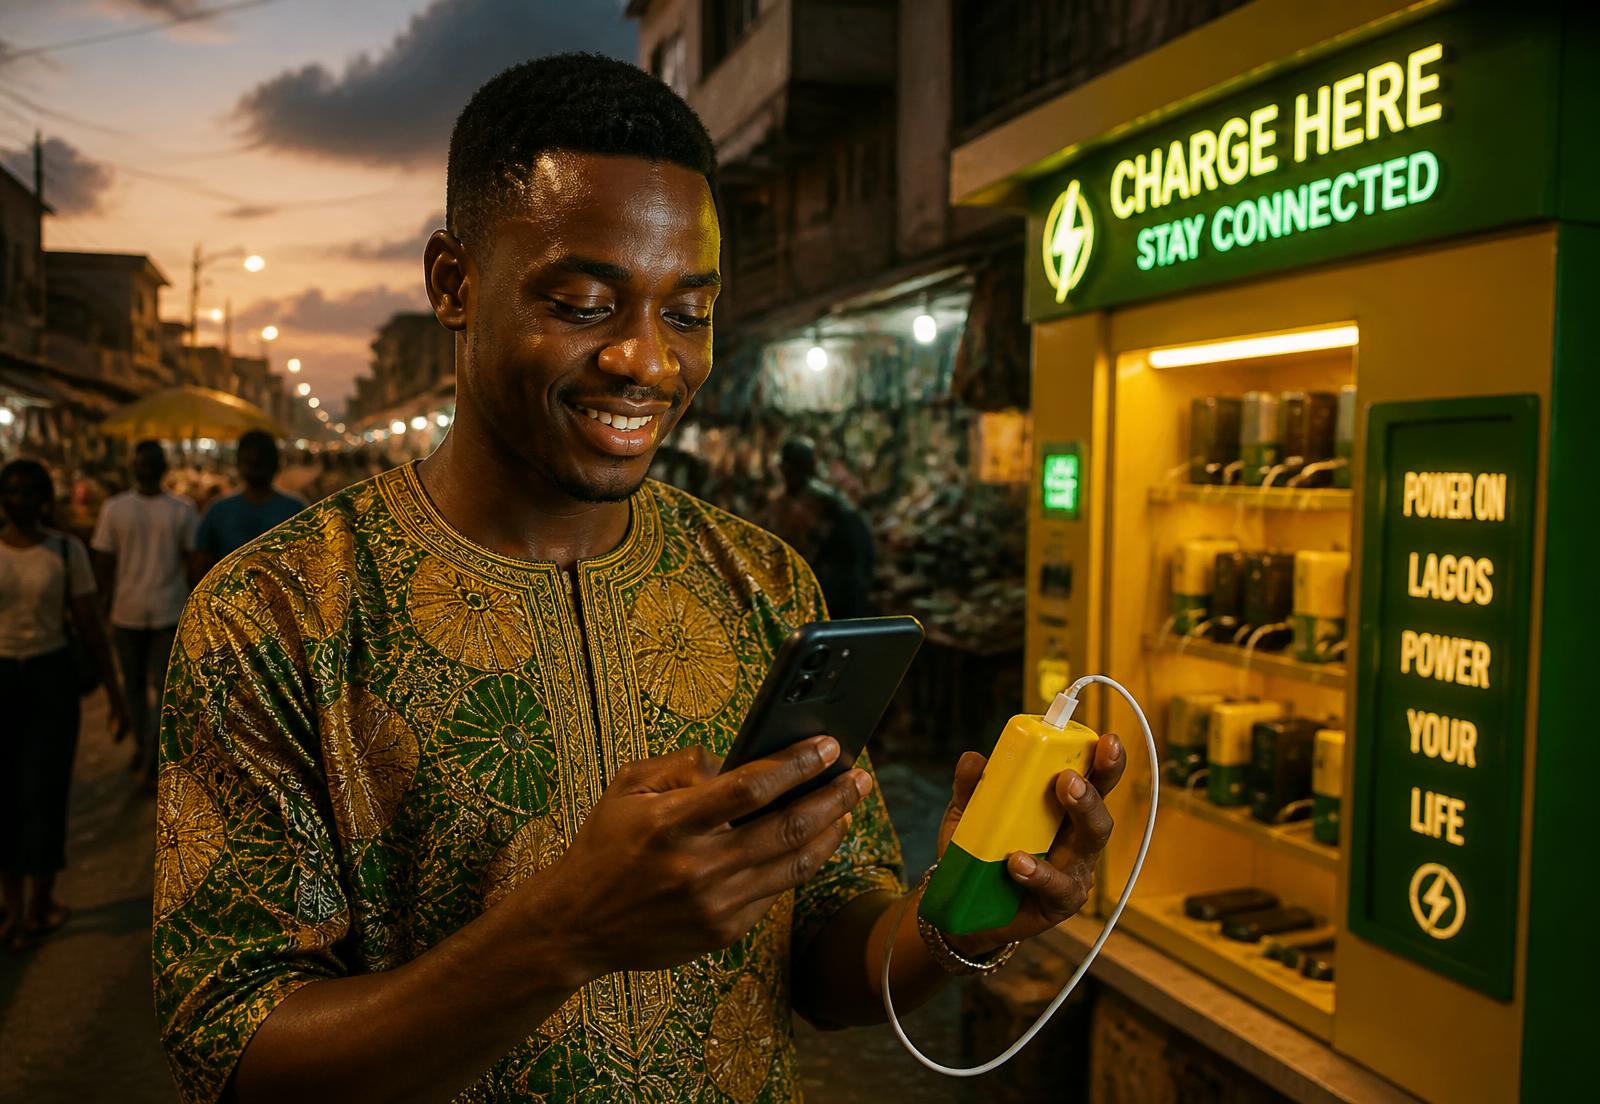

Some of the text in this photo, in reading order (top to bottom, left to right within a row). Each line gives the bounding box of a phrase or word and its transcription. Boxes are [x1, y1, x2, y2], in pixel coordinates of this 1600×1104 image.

[1110, 43, 1443, 219] CHARGE HERE
[1136, 151, 1440, 271] STAY CONNECTED
[1403, 471, 1507, 522] POWER ON
[1408, 552, 1494, 606] LAGOS
[1401, 630, 1490, 689] POWER
[1406, 708, 1477, 768] YOUR
[1410, 786, 1466, 846] LIFE
